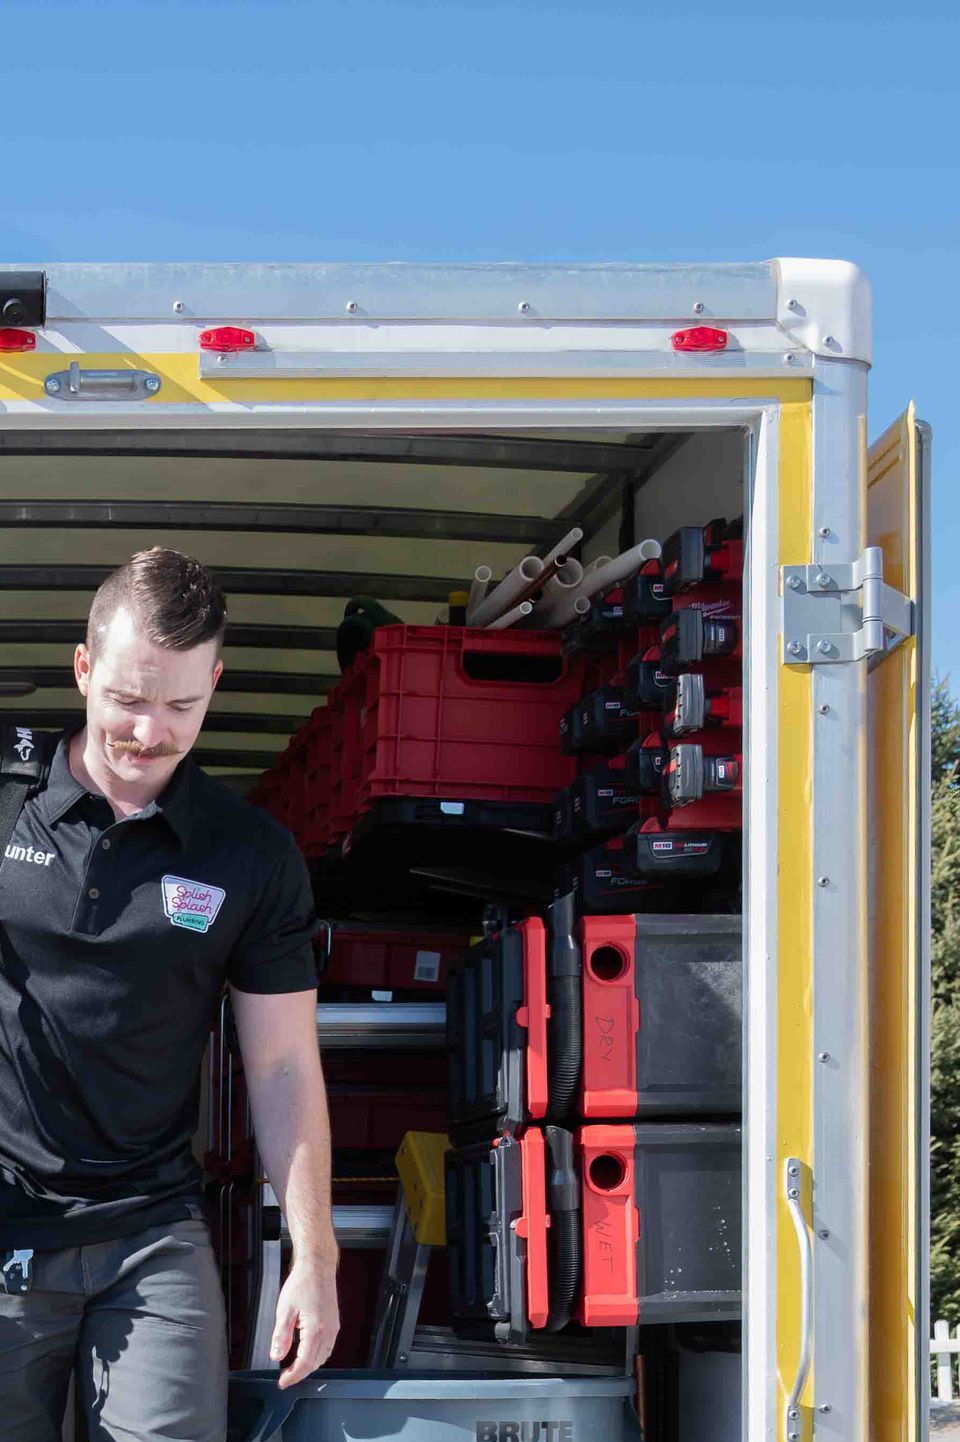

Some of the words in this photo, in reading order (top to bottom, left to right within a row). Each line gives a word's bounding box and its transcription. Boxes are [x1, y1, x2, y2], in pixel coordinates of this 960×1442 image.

[4, 844, 55, 866] unter
[176, 884, 212, 902] Splish
[171, 896, 212, 915] Splash
[175, 915, 206, 926] PLUMBING
[594, 1016, 616, 1063] DRY
[594, 1219, 616, 1275] WET
